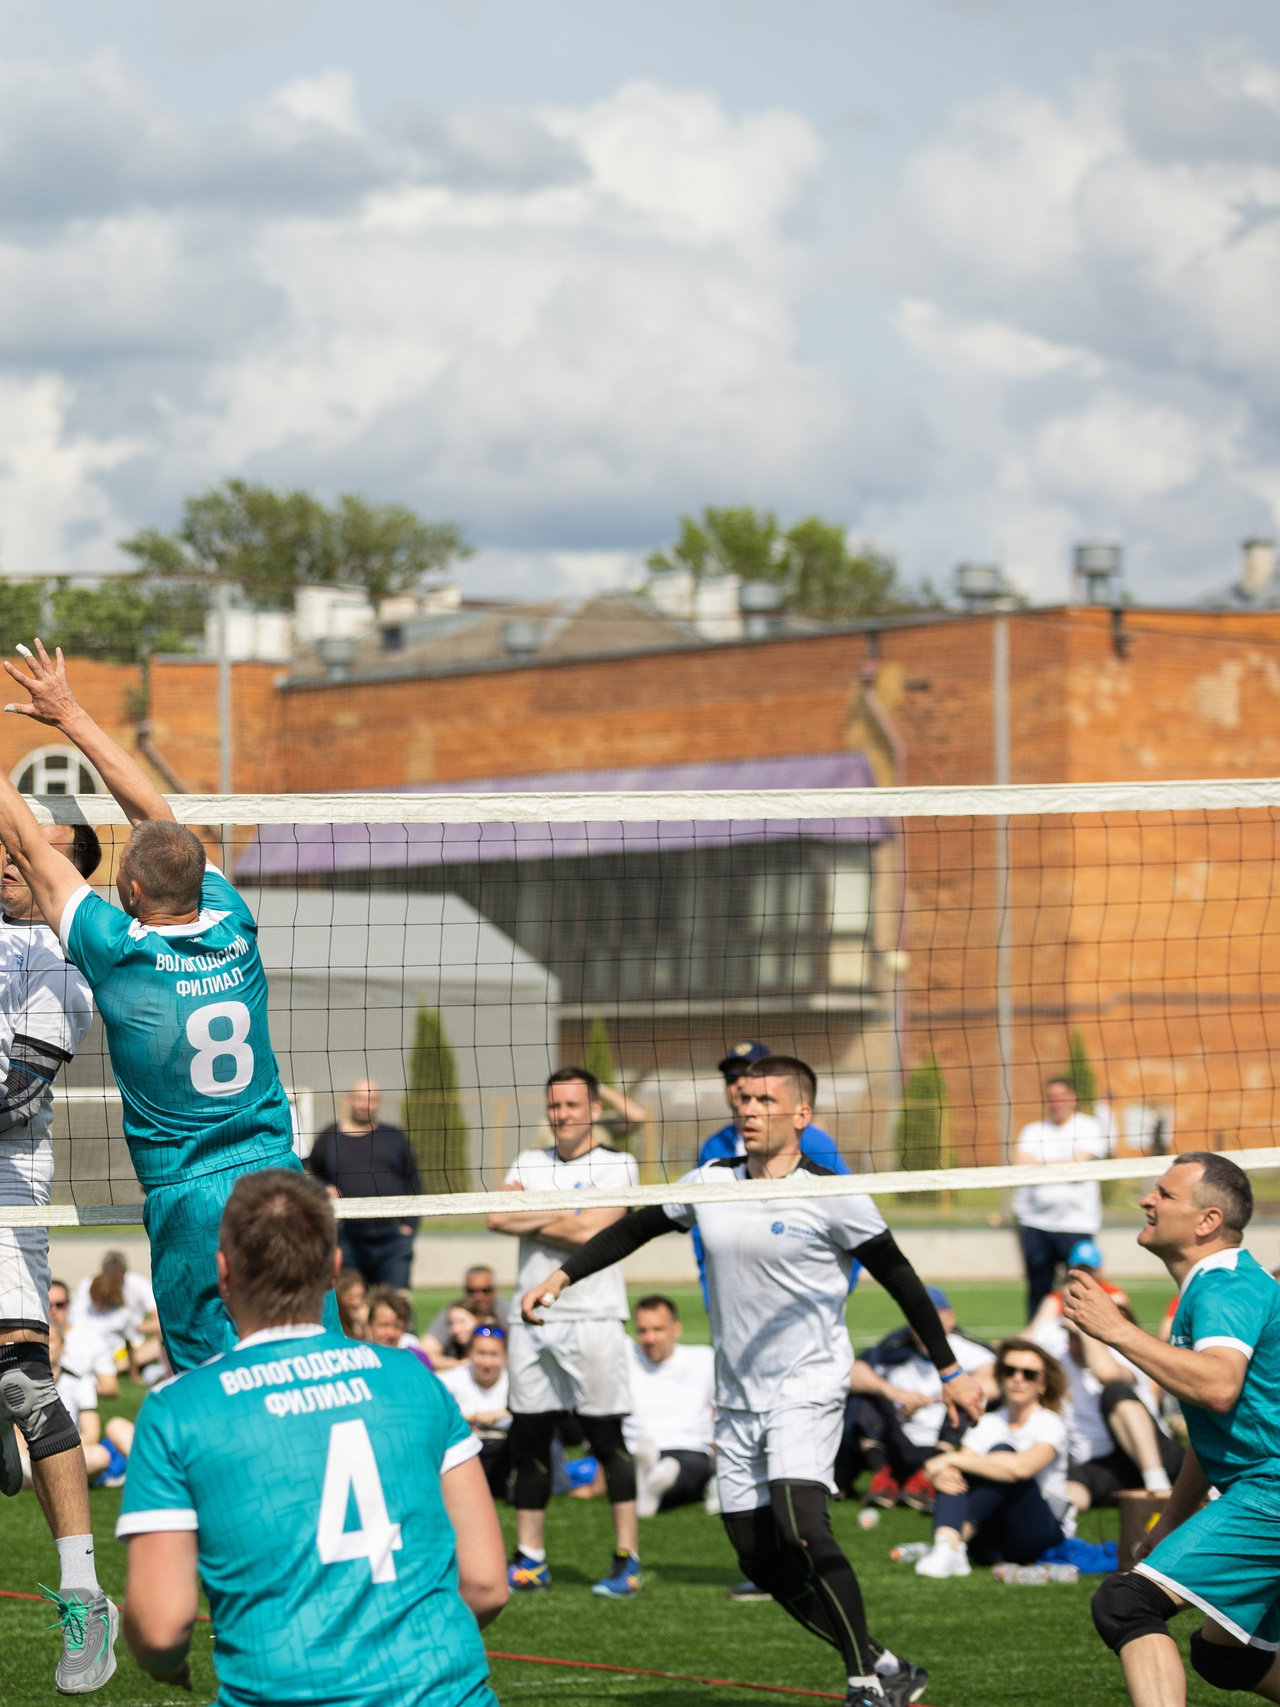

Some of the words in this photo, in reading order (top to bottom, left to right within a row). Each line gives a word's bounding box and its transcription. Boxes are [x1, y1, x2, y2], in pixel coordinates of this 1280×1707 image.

[176, 967, 245, 998] ФИЛИАЛ
[186, 1001, 255, 1098] 8
[219, 1344, 383, 1397] ВОЛОГОДСКИЙ
[263, 1376, 374, 1418] ФИЛИАЛ
[315, 1417, 404, 1585] 4
